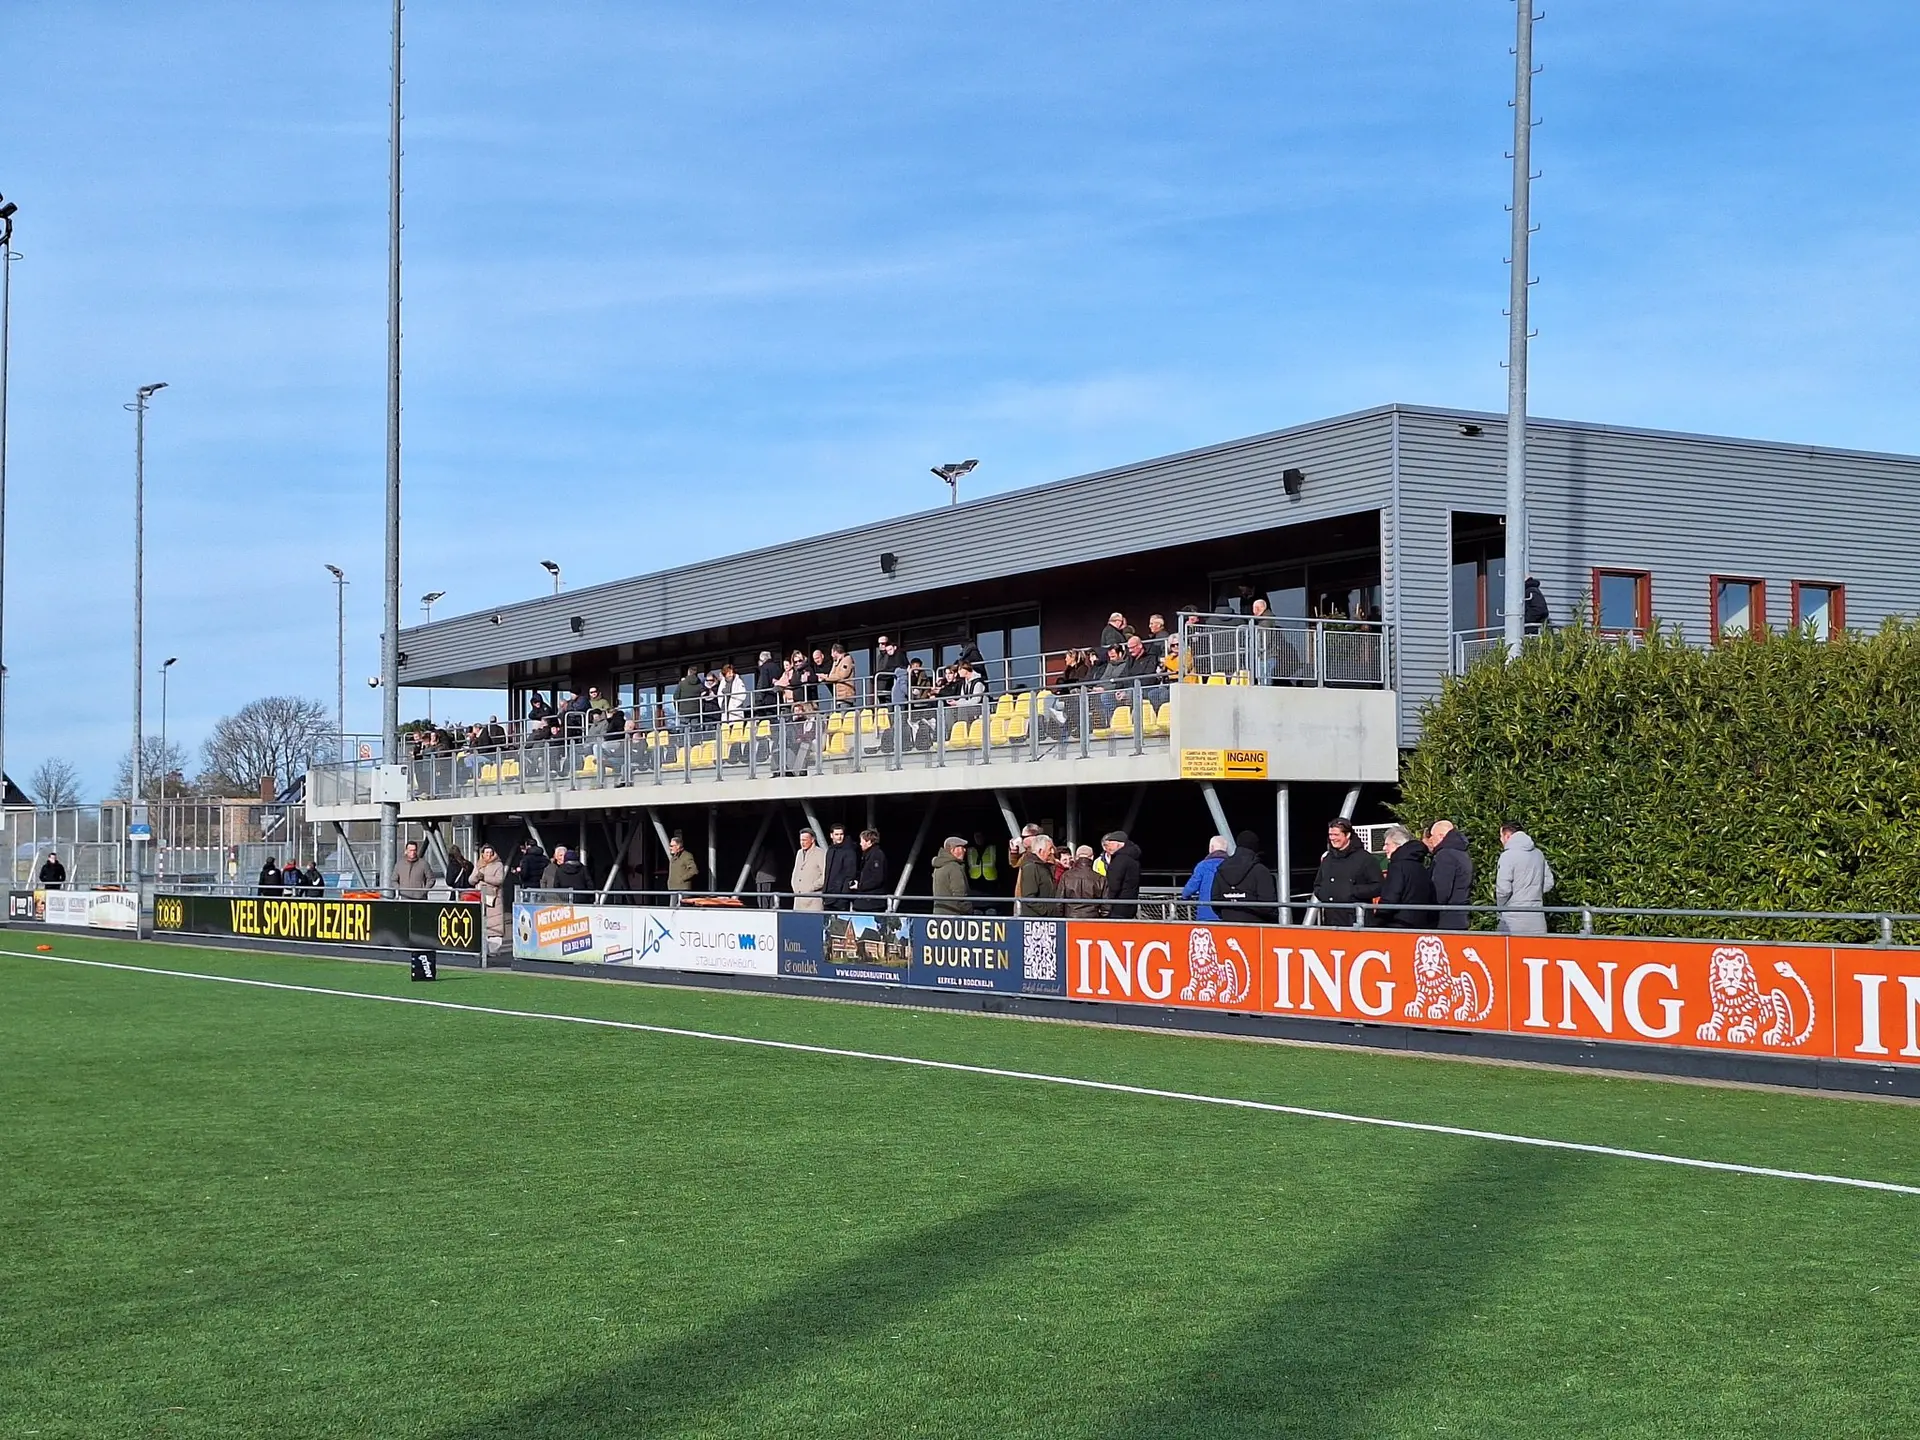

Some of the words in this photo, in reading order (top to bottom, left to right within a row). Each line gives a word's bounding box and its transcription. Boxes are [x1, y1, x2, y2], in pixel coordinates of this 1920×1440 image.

[1227, 752, 1264, 763] INGANG
[230, 899, 261, 935] VEEL
[263, 900, 371, 941] SPORTPLEZIER!
[440, 916, 470, 939] BCT
[926, 918, 1006, 943] GOUDEN
[738, 933, 756, 951] WK
[758, 934, 775, 952] 60
[792, 959, 818, 975] ontdek
[923, 945, 1010, 971] BUURTEN
[1076, 939, 1175, 1000] ING
[1273, 947, 1396, 1017] ING
[1522, 958, 1685, 1039] ING
